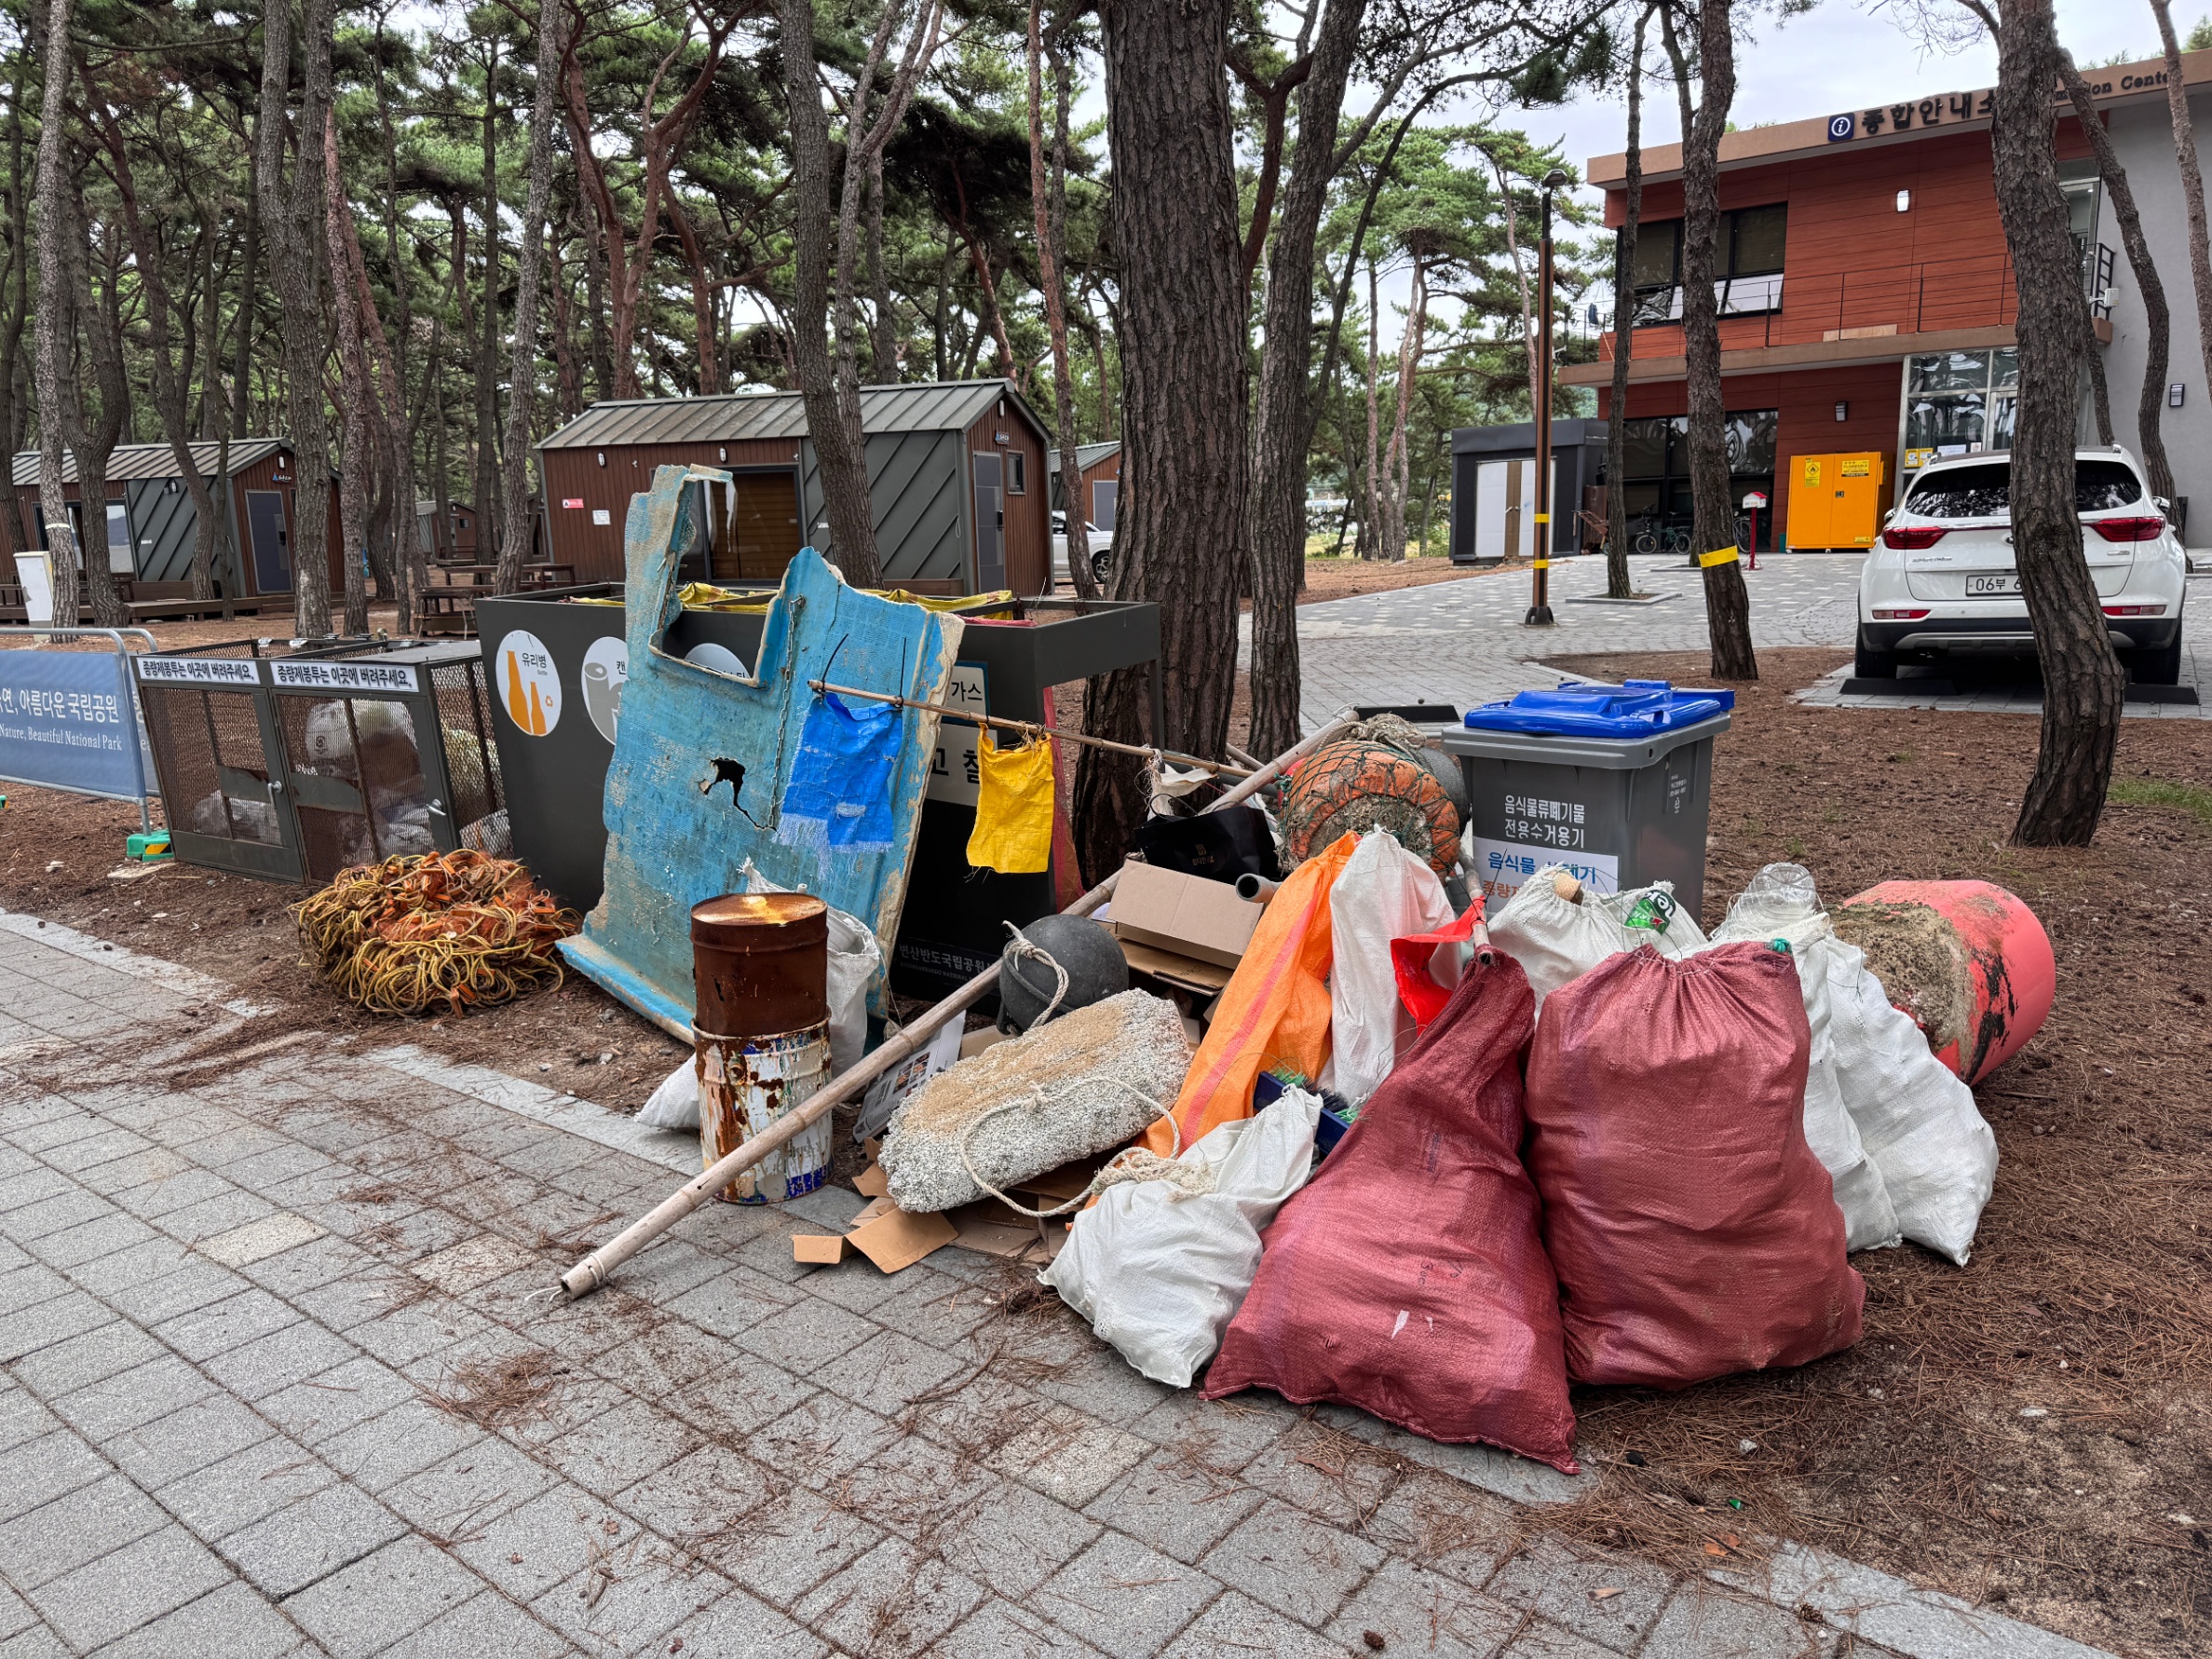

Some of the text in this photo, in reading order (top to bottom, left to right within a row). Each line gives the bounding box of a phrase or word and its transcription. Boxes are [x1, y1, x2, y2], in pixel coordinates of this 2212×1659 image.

[2121, 71, 2168, 90] Cente
[1975, 578, 2006, 592] 06부
[142, 660, 187, 677] 종량제봉투는
[187, 661, 210, 681] 이곳에
[522, 652, 548, 669] 유리병
[616, 660, 627, 675] 캔
[278, 664, 330, 685] 종량제봉투는
[331, 666, 360, 686] 이곳에
[20, 689, 66, 718] 아름다운
[67, 693, 119, 724] 국립공원
[28, 726, 64, 745] Beautiful
[64, 730, 101, 749] National
[102, 734, 123, 752] Park
[1504, 795, 1585, 824] 음식물류폐기물
[1505, 818, 1584, 849] 전용수거용기
[1488, 851, 1536, 875] 음식물
